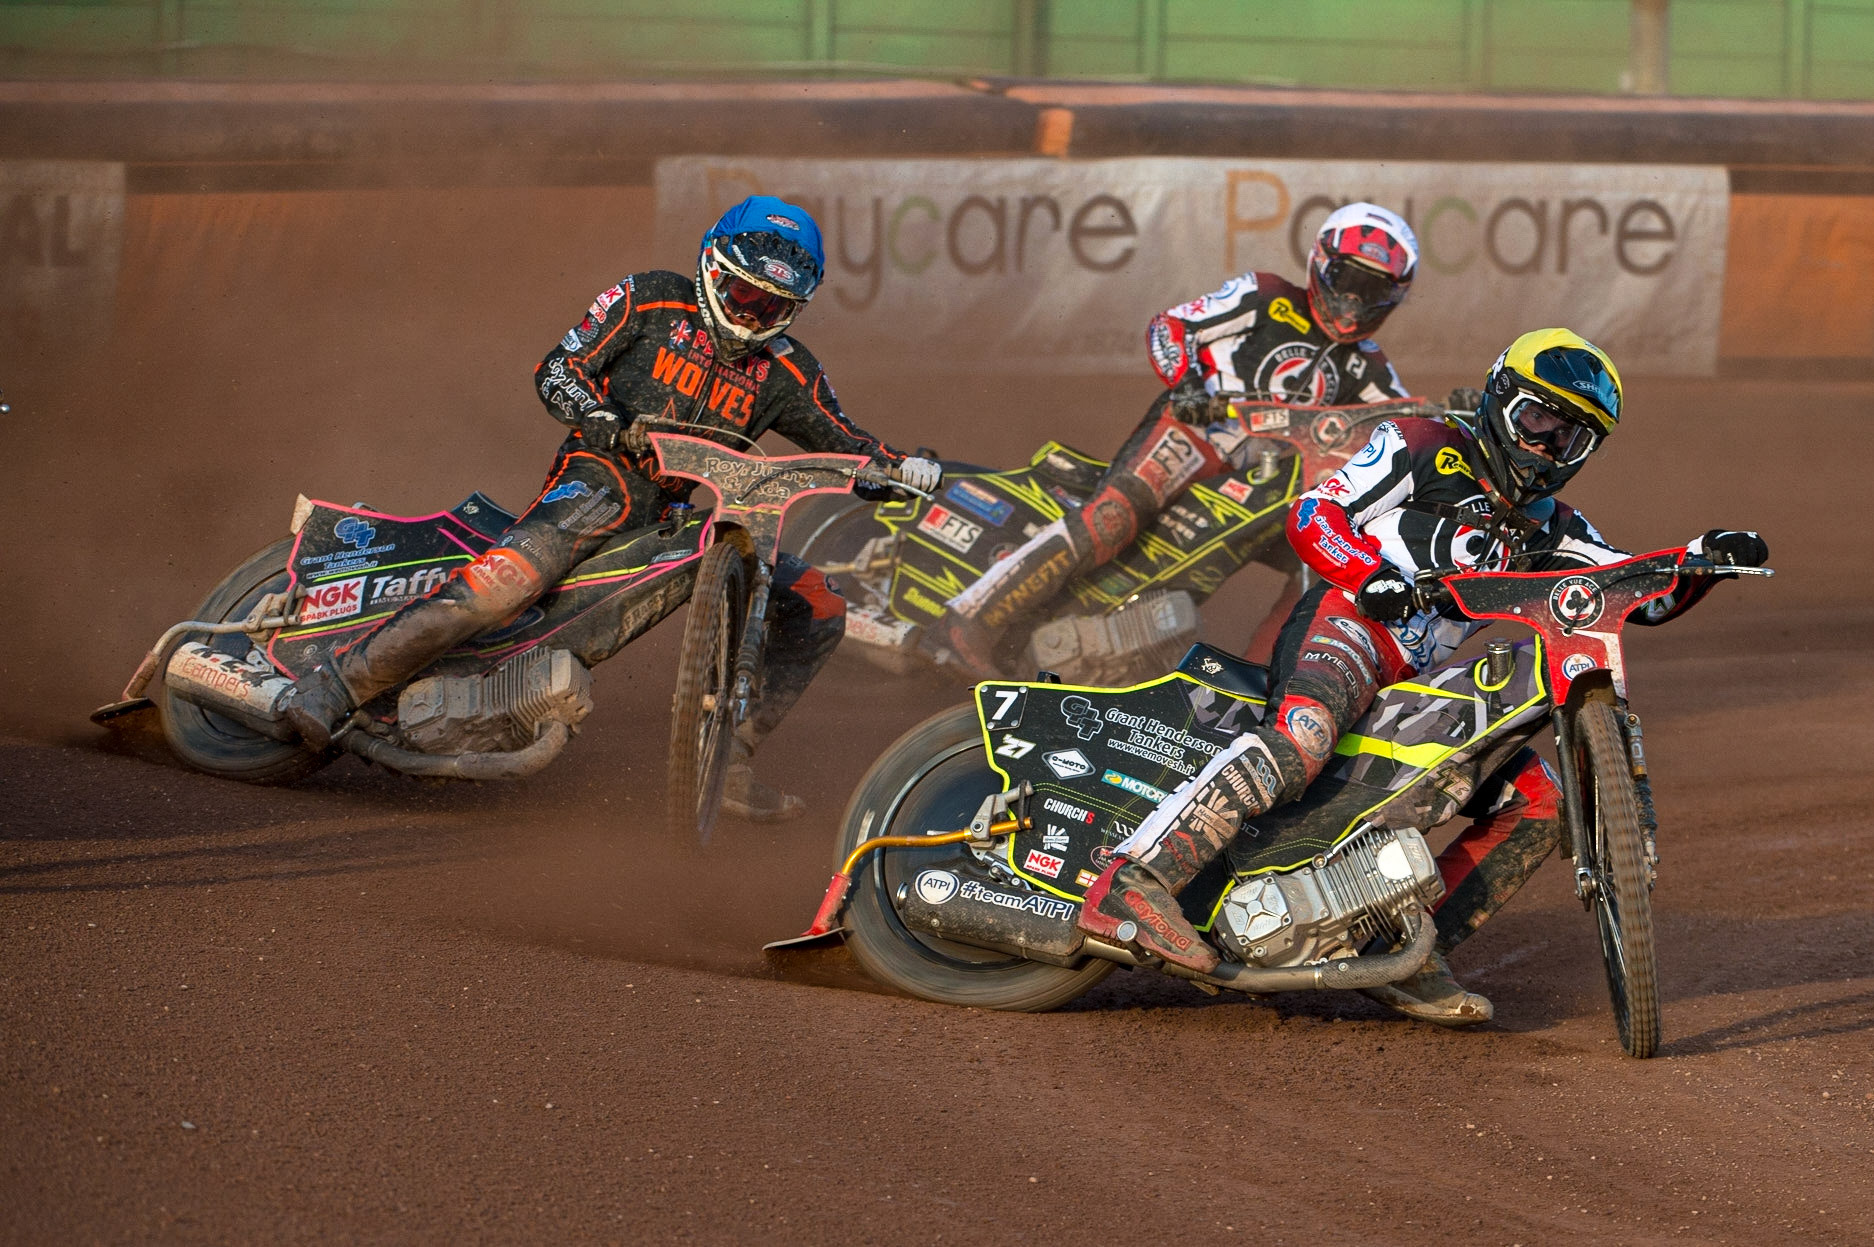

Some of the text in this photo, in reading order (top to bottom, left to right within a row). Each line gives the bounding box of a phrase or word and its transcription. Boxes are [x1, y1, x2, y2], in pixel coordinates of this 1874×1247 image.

[705, 166, 1137, 310] Pycare
[1223, 169, 1676, 276] Pacare
[1152, 430, 1192, 475] FTS
[942, 515, 979, 544] FTS
[301, 580, 361, 613] NGK
[301, 604, 357, 623] SPARK PLUGS
[181, 656, 251, 698] Campers
[991, 690, 1018, 720] 7
[1105, 708, 1146, 729] Grant
[1107, 738, 1196, 776] www.wemovesh.it
[1128, 729, 1185, 760] Tankers
[1044, 798, 1095, 825] CHURCHS
[1028, 853, 1061, 872] NGK
[923, 877, 1075, 921] ATPI #teamATPI
[1123, 890, 1192, 951] daytona
